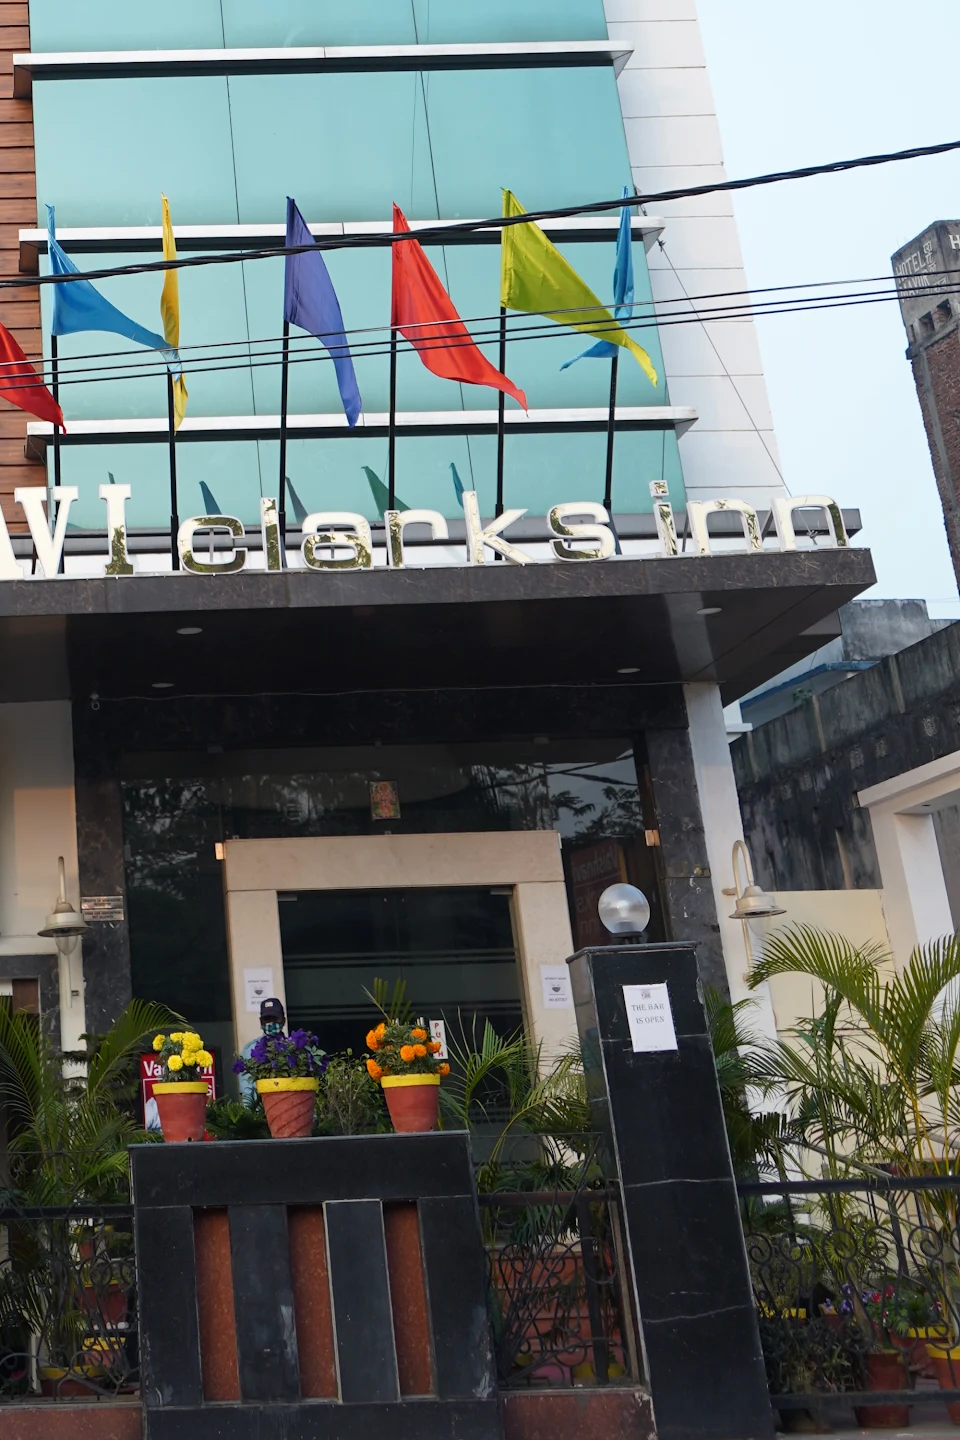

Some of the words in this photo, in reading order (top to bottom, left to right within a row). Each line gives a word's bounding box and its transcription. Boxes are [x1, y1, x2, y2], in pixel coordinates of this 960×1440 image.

[178, 490, 617, 576] clarks
[649, 479, 849, 557] inn
[648, 1003, 665, 1011] BAR
[645, 1016, 665, 1024] OPEN
[434, 1022, 444, 1057] PUH
